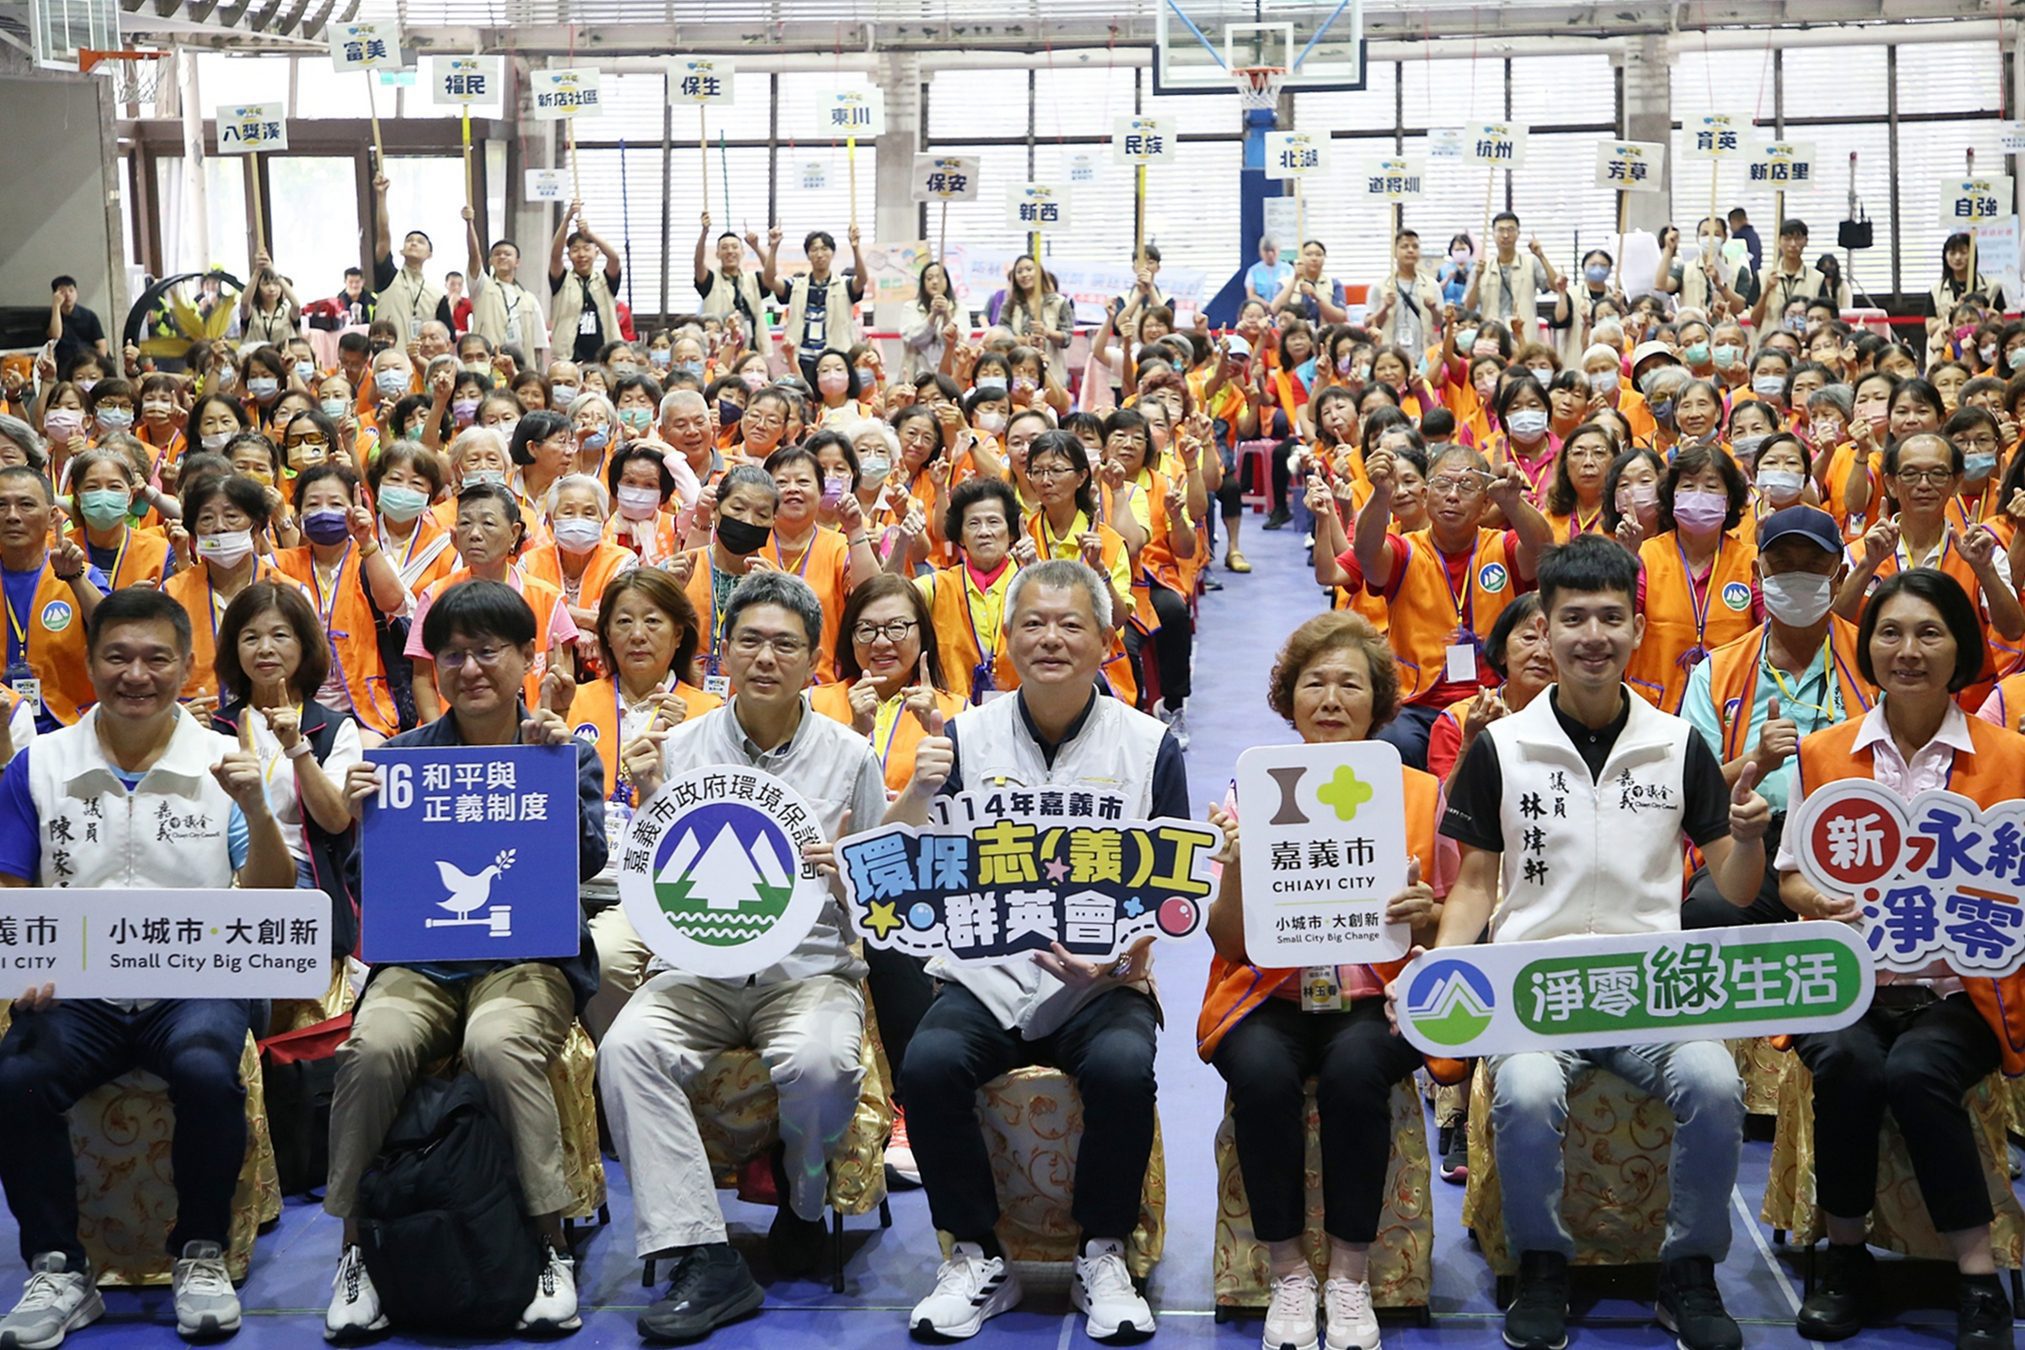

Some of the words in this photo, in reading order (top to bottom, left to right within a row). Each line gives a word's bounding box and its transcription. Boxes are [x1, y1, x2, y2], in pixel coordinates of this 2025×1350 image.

[343, 38, 387, 62] 富美
[445, 74, 485, 95] 福民
[680, 76, 721, 96] 保生
[538, 89, 597, 107] 新店社區
[831, 107, 870, 126] 東川
[1125, 135, 1163, 155] 民族
[1476, 140, 1513, 159] 杭州
[1697, 131, 1737, 150] 育英
[1280, 149, 1318, 168] 北湖
[1608, 161, 1648, 181] 芳草
[1750, 162, 1809, 180] 新店里
[926, 173, 967, 192] 保安
[1019, 203, 1058, 222] 新西
[1955, 197, 1997, 217] 自強
[374, 763, 414, 809] 16
[422, 761, 517, 791] 和平與
[1549, 770, 1570, 819] 議員
[422, 792, 549, 823] 正義制度
[934, 791, 1124, 826] 114年嘉義市
[83, 796, 103, 843] 議員
[1519, 791, 1550, 886] 林煒軒
[49, 814, 76, 888] 陳家
[1271, 837, 1375, 870] 嘉義市
[1272, 878, 1331, 893] CHIAYI
[1338, 876, 1376, 890] CITY
[944, 889, 1117, 949] 群英會
[1862, 885, 2024, 959] 淨零
[1276, 934, 1303, 944] Small
[1304, 934, 1325, 943] City
[1327, 932, 1343, 943] Big
[1344, 931, 1380, 941] Change
[14, 956, 57, 969] CITY
[110, 953, 160, 968] Small
[167, 953, 207, 972] City
[213, 954, 243, 973] Big
[248, 954, 318, 973] Change
[1531, 943, 1840, 1023] 淨零綠生活
